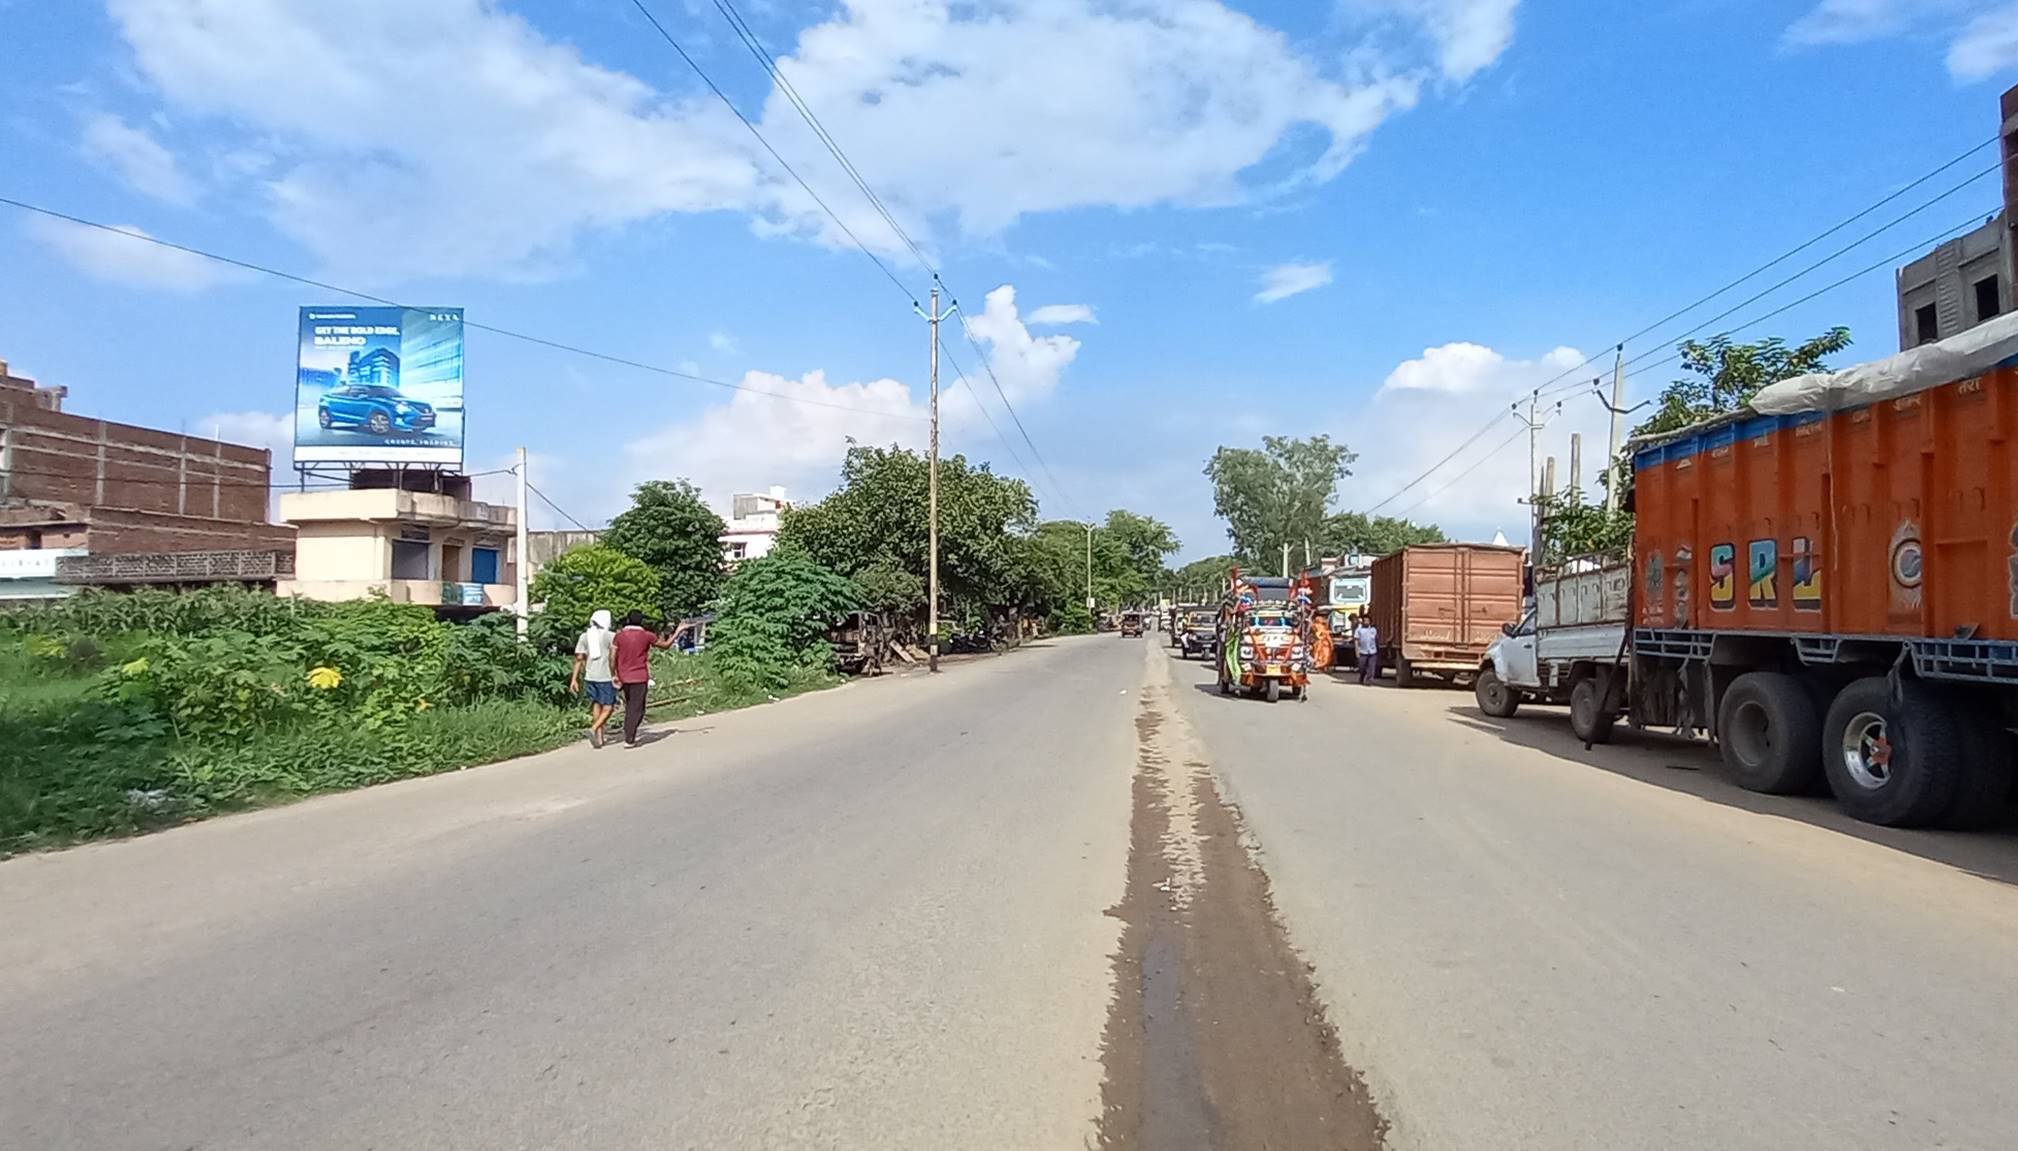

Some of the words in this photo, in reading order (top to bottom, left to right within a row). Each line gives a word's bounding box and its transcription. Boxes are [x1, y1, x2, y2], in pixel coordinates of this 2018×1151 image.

[429, 313, 460, 321] NEXA
[314, 326, 332, 335] GET
[333, 326, 349, 335] THE
[350, 326, 374, 335] BOLD
[314, 336, 367, 345] BALENO
